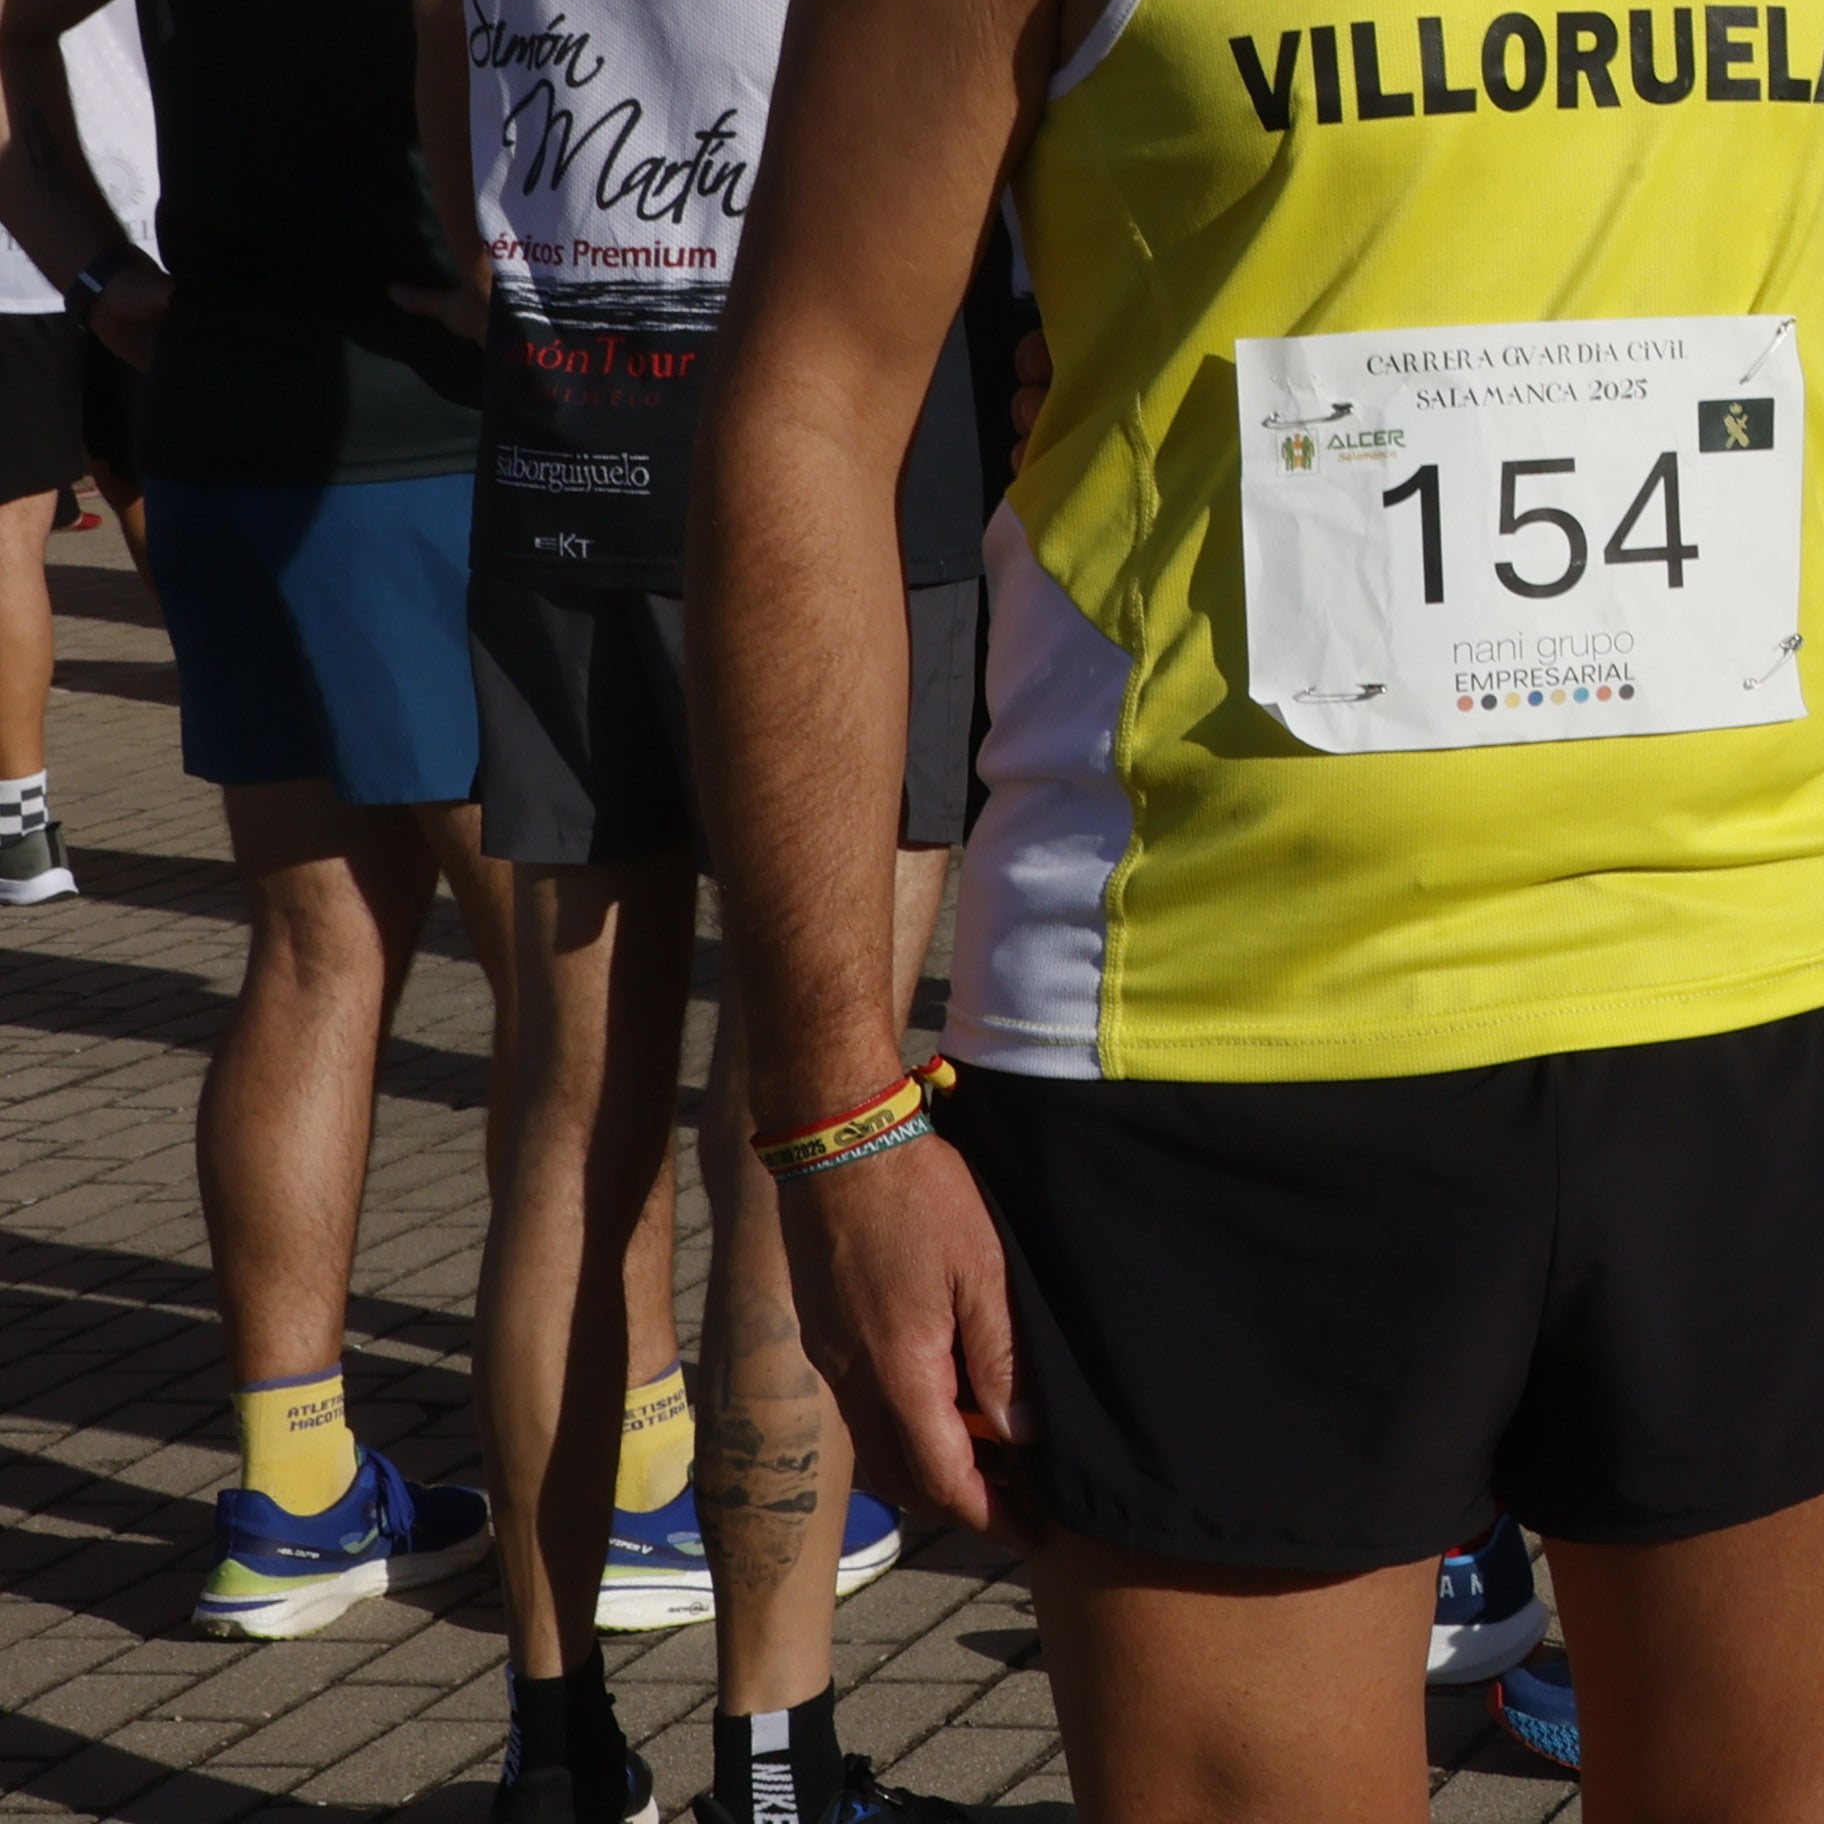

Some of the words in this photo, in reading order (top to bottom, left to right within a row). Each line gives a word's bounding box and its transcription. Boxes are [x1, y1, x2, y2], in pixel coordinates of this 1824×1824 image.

[502, 78, 748, 224] Martín
[573, 239, 717, 269] Premium
[597, 335, 696, 378] Tour
[1366, 348, 1494, 376] CARRERA
[1416, 380, 1579, 411] SALAMANCA
[1588, 376, 1649, 401] 2025
[1326, 429, 1406, 452] ALCER
[1382, 451, 1700, 605] 154
[1453, 633, 1524, 665] nani
[1537, 629, 1635, 663] grupo
[1455, 661, 1636, 693] EMPRESARIAL
